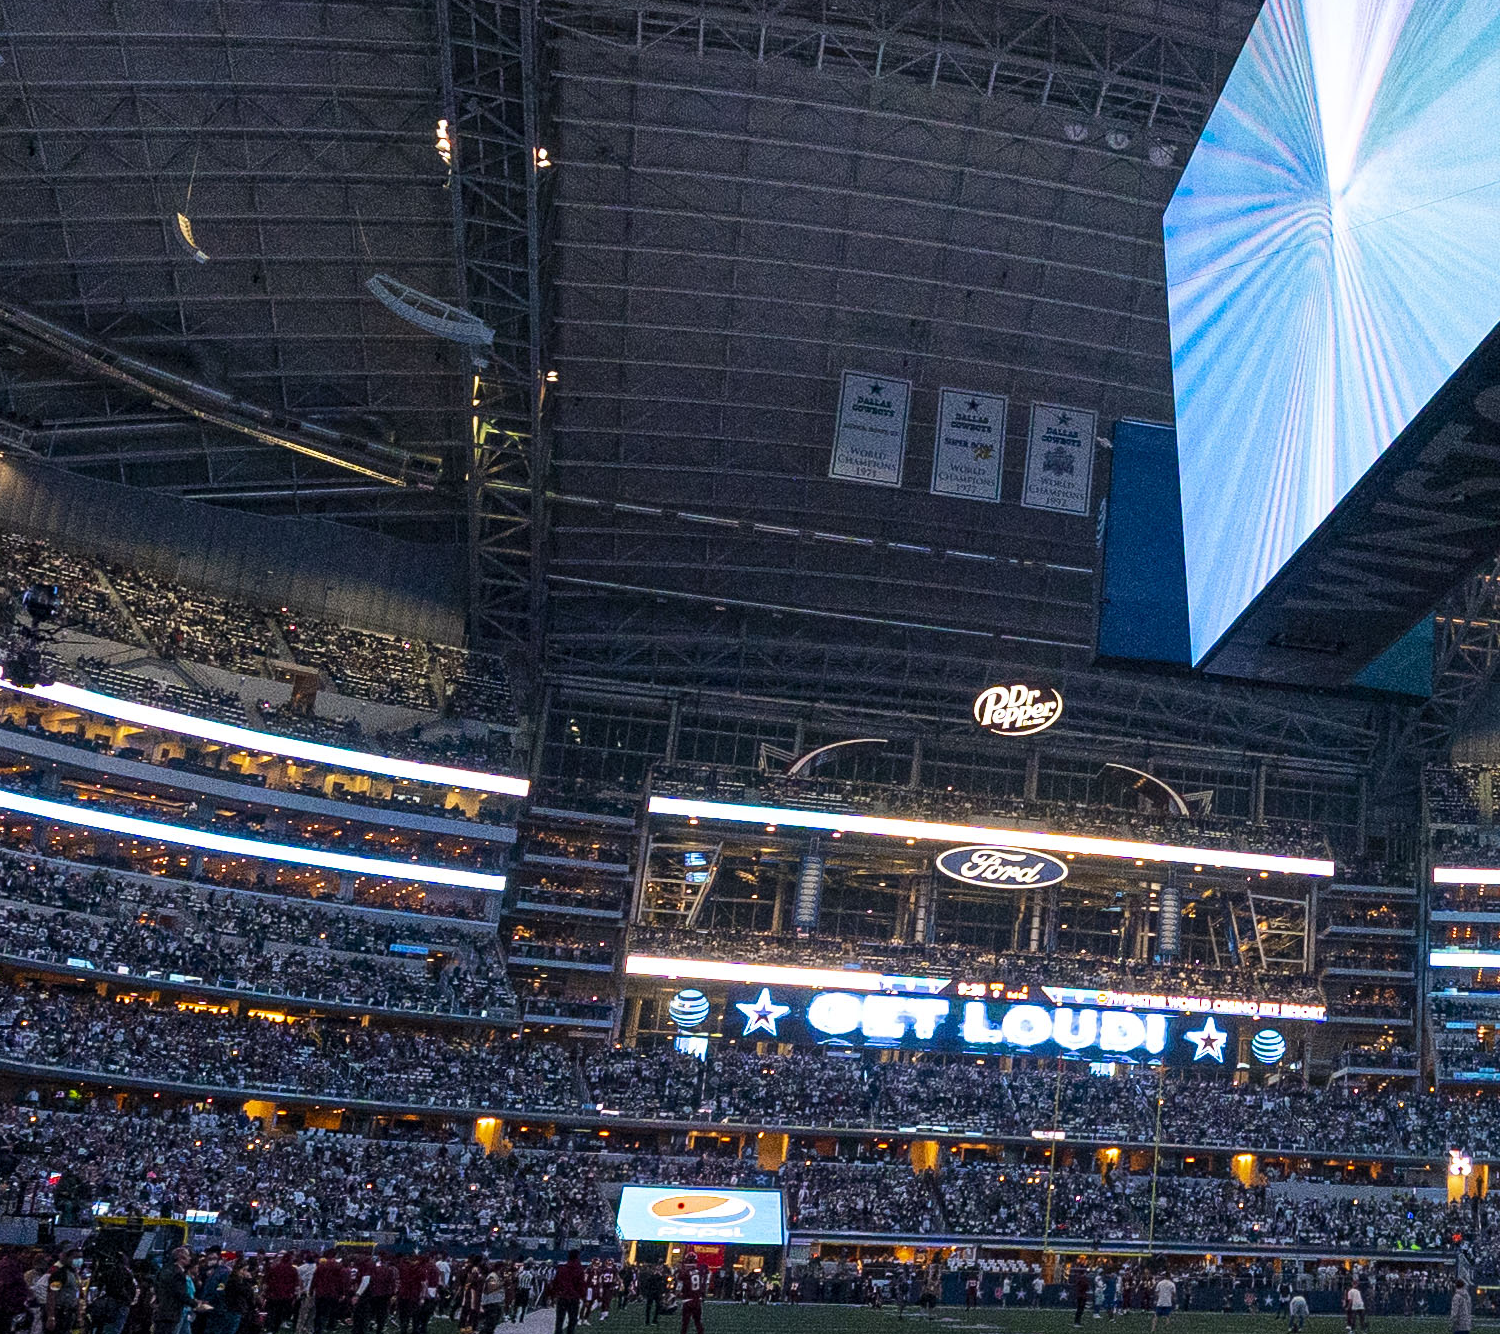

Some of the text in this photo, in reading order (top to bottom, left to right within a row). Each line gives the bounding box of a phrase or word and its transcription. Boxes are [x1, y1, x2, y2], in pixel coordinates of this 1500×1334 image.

[856, 395, 893, 409] DALLAS
[851, 403, 896, 418] COWBOYS
[955, 413, 990, 424] DALLAS
[950, 420, 993, 433] COWBOYS
[1046, 427, 1079, 439] DALLAS
[1041, 434, 1082, 447] COWBOYS
[850, 447, 887, 460] WORLD
[838, 454, 897, 472] CHAMPIONS
[950, 463, 986, 476] WORLD
[938, 472, 996, 487] CHAMPIONS
[1040, 476, 1076, 489] WORLD
[1028, 483, 1085, 501] CHAMPIONS
[1007, 684, 1041, 707] Dr
[980, 686, 1057, 730] Pepper
[960, 850, 1046, 883] Ford
[1168, 995, 1212, 1012] WORLD
[1281, 1004, 1327, 1019] RESORT
[808, 991, 1168, 1055] GET LOUD!
[656, 1226, 745, 1238] pepsi
[691, 1273, 701, 1291] 8
